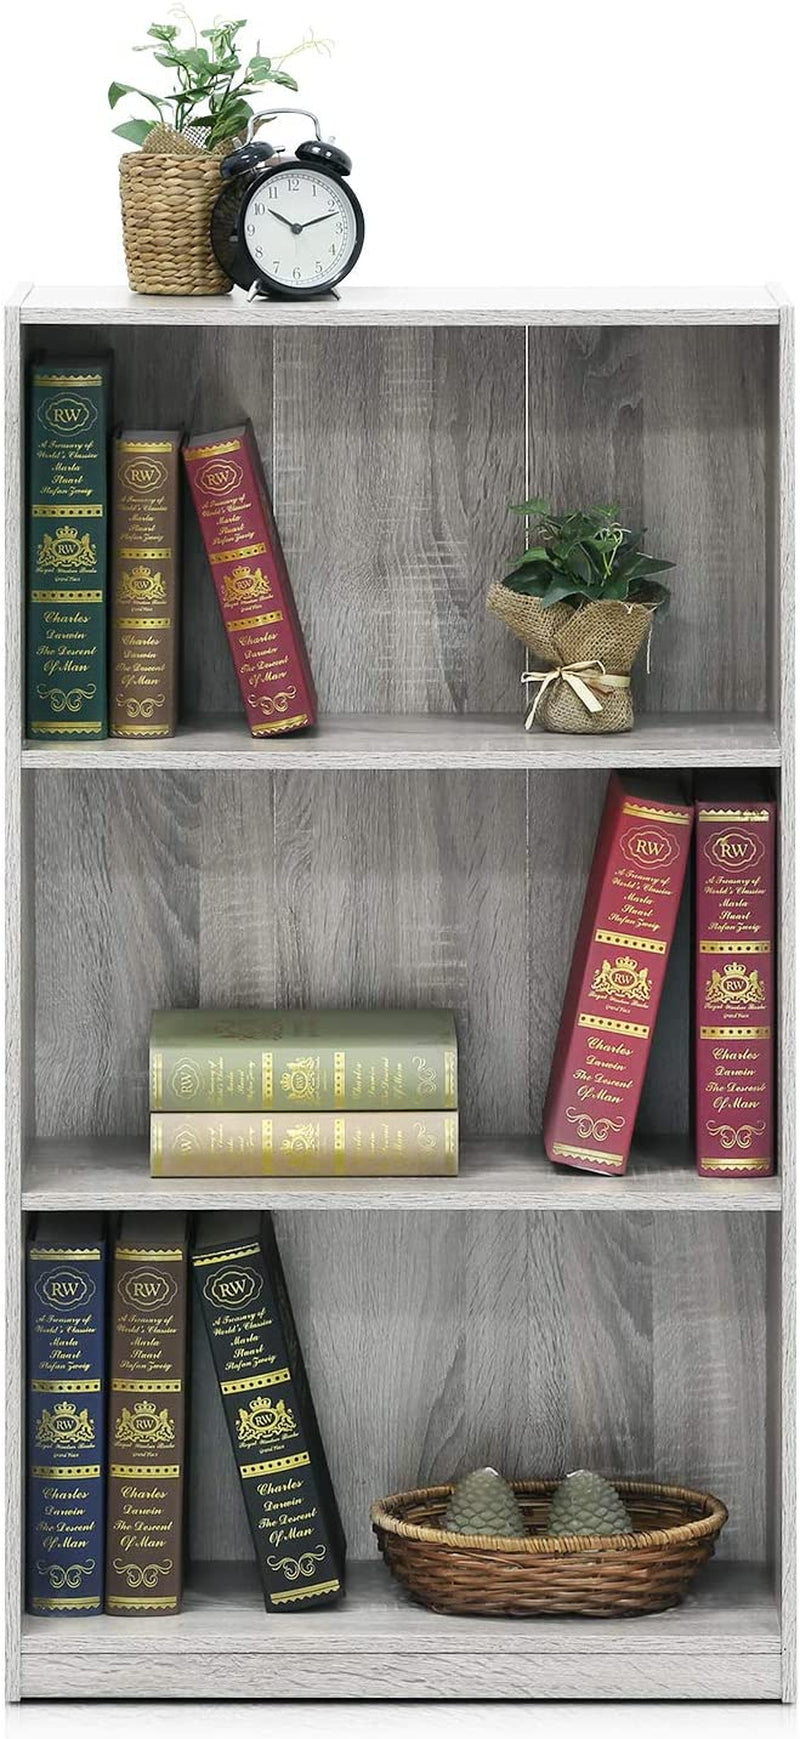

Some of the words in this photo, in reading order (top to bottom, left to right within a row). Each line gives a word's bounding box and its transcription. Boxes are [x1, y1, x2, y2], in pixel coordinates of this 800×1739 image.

[287, 179, 299, 191] 12
[312, 185, 317, 196] 1
[268, 187, 277, 199] 11
[254, 203, 266, 215] 10
[328, 201, 335, 211] 2
[247, 225, 255, 236] 9
[336, 223, 343, 234] 3
[255, 247, 263, 258] 8
[329, 244, 336, 255] 4
[273, 262, 280, 273] 7
[315, 262, 322, 272] 5
[293, 268, 301, 280] 6
[55, 409, 81, 423] RW
[59, 545, 76, 554] RW
[637, 840, 664, 856] RW
[722, 844, 748, 858] RW
[615, 974, 632, 984] RW
[727, 982, 744, 990] RW
[588, 1037, 633, 1056] Charles
[713, 1049, 760, 1060] Charles
[586, 1056, 624, 1071] Darwin
[716, 1067, 754, 1076] Darwin
[573, 1070, 592, 1081] The
[595, 1074, 633, 1088] Descent
[727, 1083, 766, 1092] Descent
[578, 1086, 595, 1101] Of
[592, 1090, 623, 1103] Man
[713, 1097, 729, 1113] Of
[728, 1097, 759, 1108] Man
[52, 1283, 79, 1297] RW
[135, 1283, 161, 1297] RW
[220, 1279, 246, 1297] RW
[137, 1420, 154, 1429] RW
[256, 1414, 272, 1425] RW
[57, 1421, 74, 1430] RW
[257, 1478, 304, 1496] Charles
[43, 1488, 90, 1499] Charles
[121, 1487, 168, 1499] Charles
[124, 1506, 162, 1515] Darwin
[264, 1498, 302, 1512] Darwin
[45, 1507, 84, 1515] Darwin
[259, 1518, 277, 1529] The
[279, 1508, 316, 1525] Descent
[135, 1522, 173, 1531] Descent
[58, 1537, 89, 1548] Man
[270, 1530, 284, 1547] Of
[284, 1527, 314, 1540] Man
[121, 1536, 137, 1551] Of
[136, 1536, 166, 1547] Man
